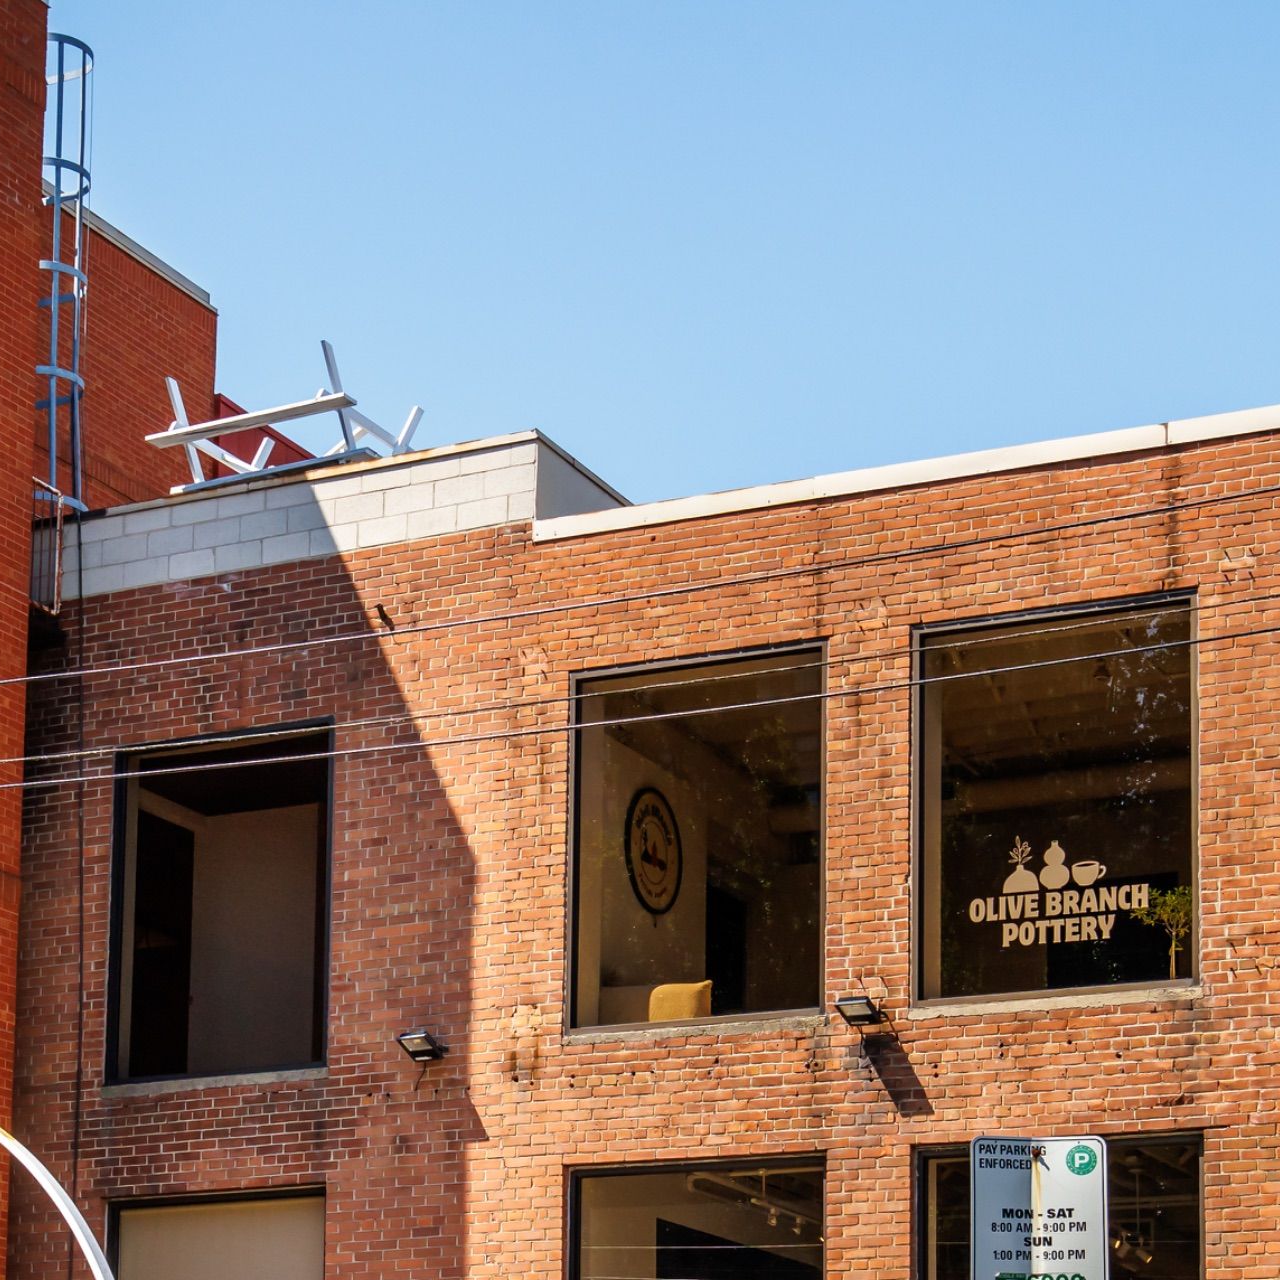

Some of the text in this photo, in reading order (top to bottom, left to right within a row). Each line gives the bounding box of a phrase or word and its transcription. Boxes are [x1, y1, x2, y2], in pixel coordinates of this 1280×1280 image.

[969, 884, 1149, 923] OLIVE BRANCH
[1002, 914, 1116, 948] POTTERY
[980, 1144, 997, 1155] PAY
[980, 1158, 1032, 1170] ENFORCED
[1002, 1208, 1034, 1219] MON
[1047, 1208, 1074, 1218] SAT
[991, 1222, 1012, 1233] 8:00
[1016, 1223, 1033, 1233] AM
[1042, 1222, 1065, 1233] 9:00
[1069, 1221, 1087, 1232] PM
[1024, 1236, 1052, 1247] SUN
[993, 1250, 1012, 1261] 1:00
[1016, 1250, 1032, 1260] PM
[1043, 1250, 1064, 1261] 9:00
[1067, 1249, 1086, 1260] PM
